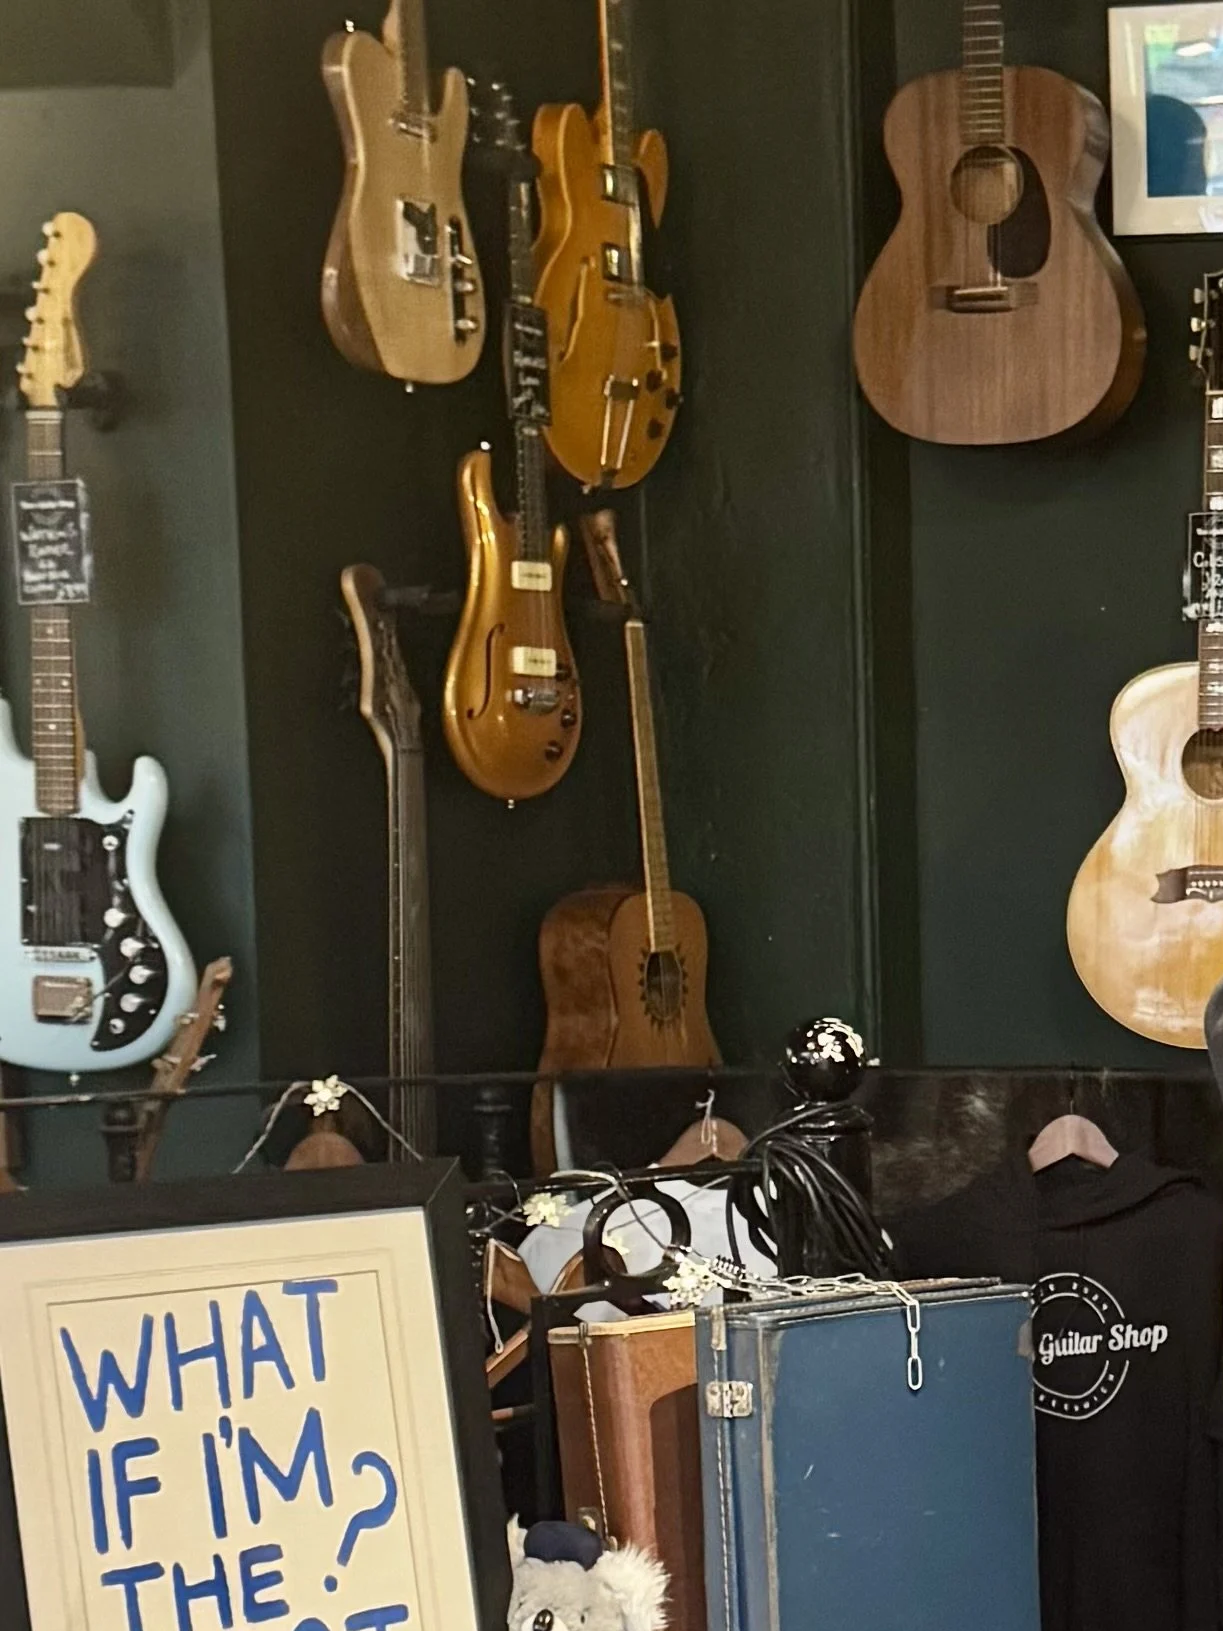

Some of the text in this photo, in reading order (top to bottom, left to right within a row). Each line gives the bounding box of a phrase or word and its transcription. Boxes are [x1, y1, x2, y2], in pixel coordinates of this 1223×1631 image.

[59, 1279, 338, 1432] WHAT
[1108, 1323, 1168, 1352] Shop
[87, 1437, 161, 1555] IF
[202, 1407, 333, 1539] I'M
